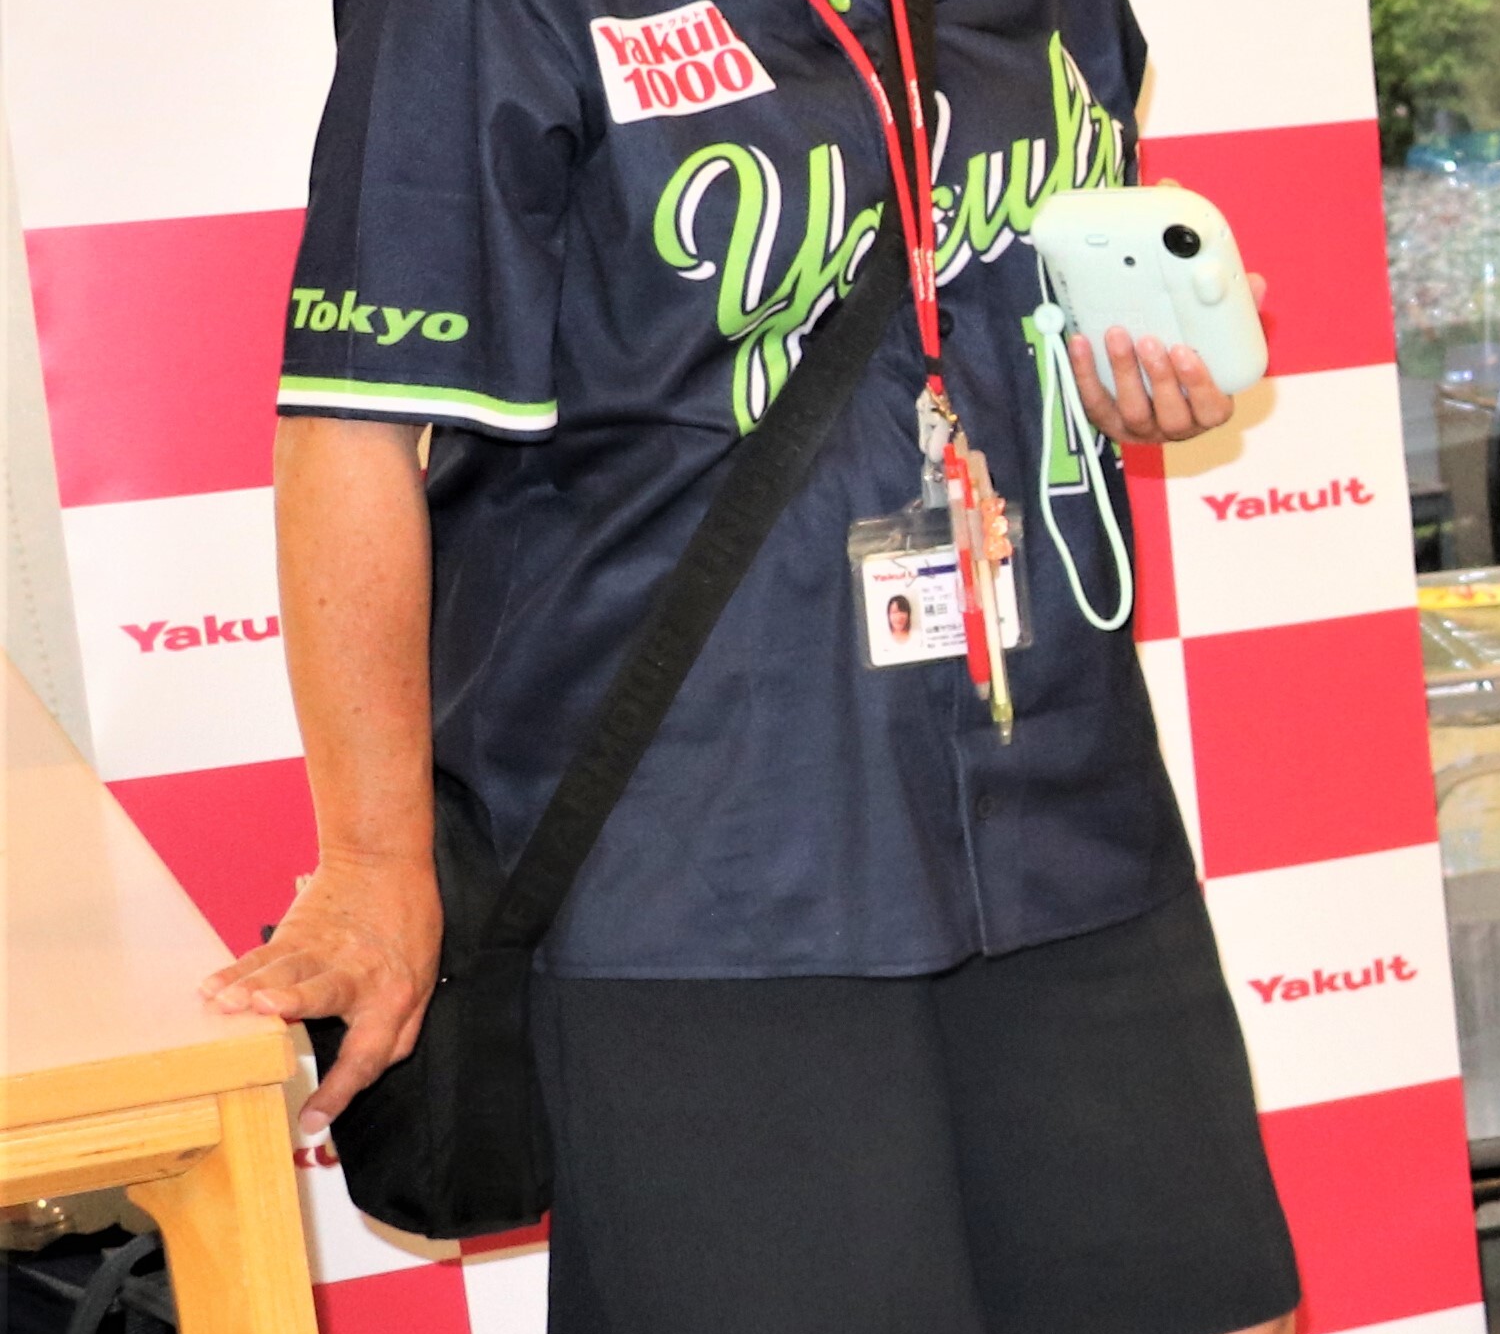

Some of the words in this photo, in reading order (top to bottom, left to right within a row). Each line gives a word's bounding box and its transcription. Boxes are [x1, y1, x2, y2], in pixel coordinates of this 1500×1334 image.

[597, 6, 733, 66] Yakul
[623, 48, 754, 111] 1000
[290, 285, 470, 344] Tokyo
[1203, 476, 1375, 522] Yakult
[120, 614, 281, 654] Yaku
[1246, 953, 1418, 1005] Yakult
